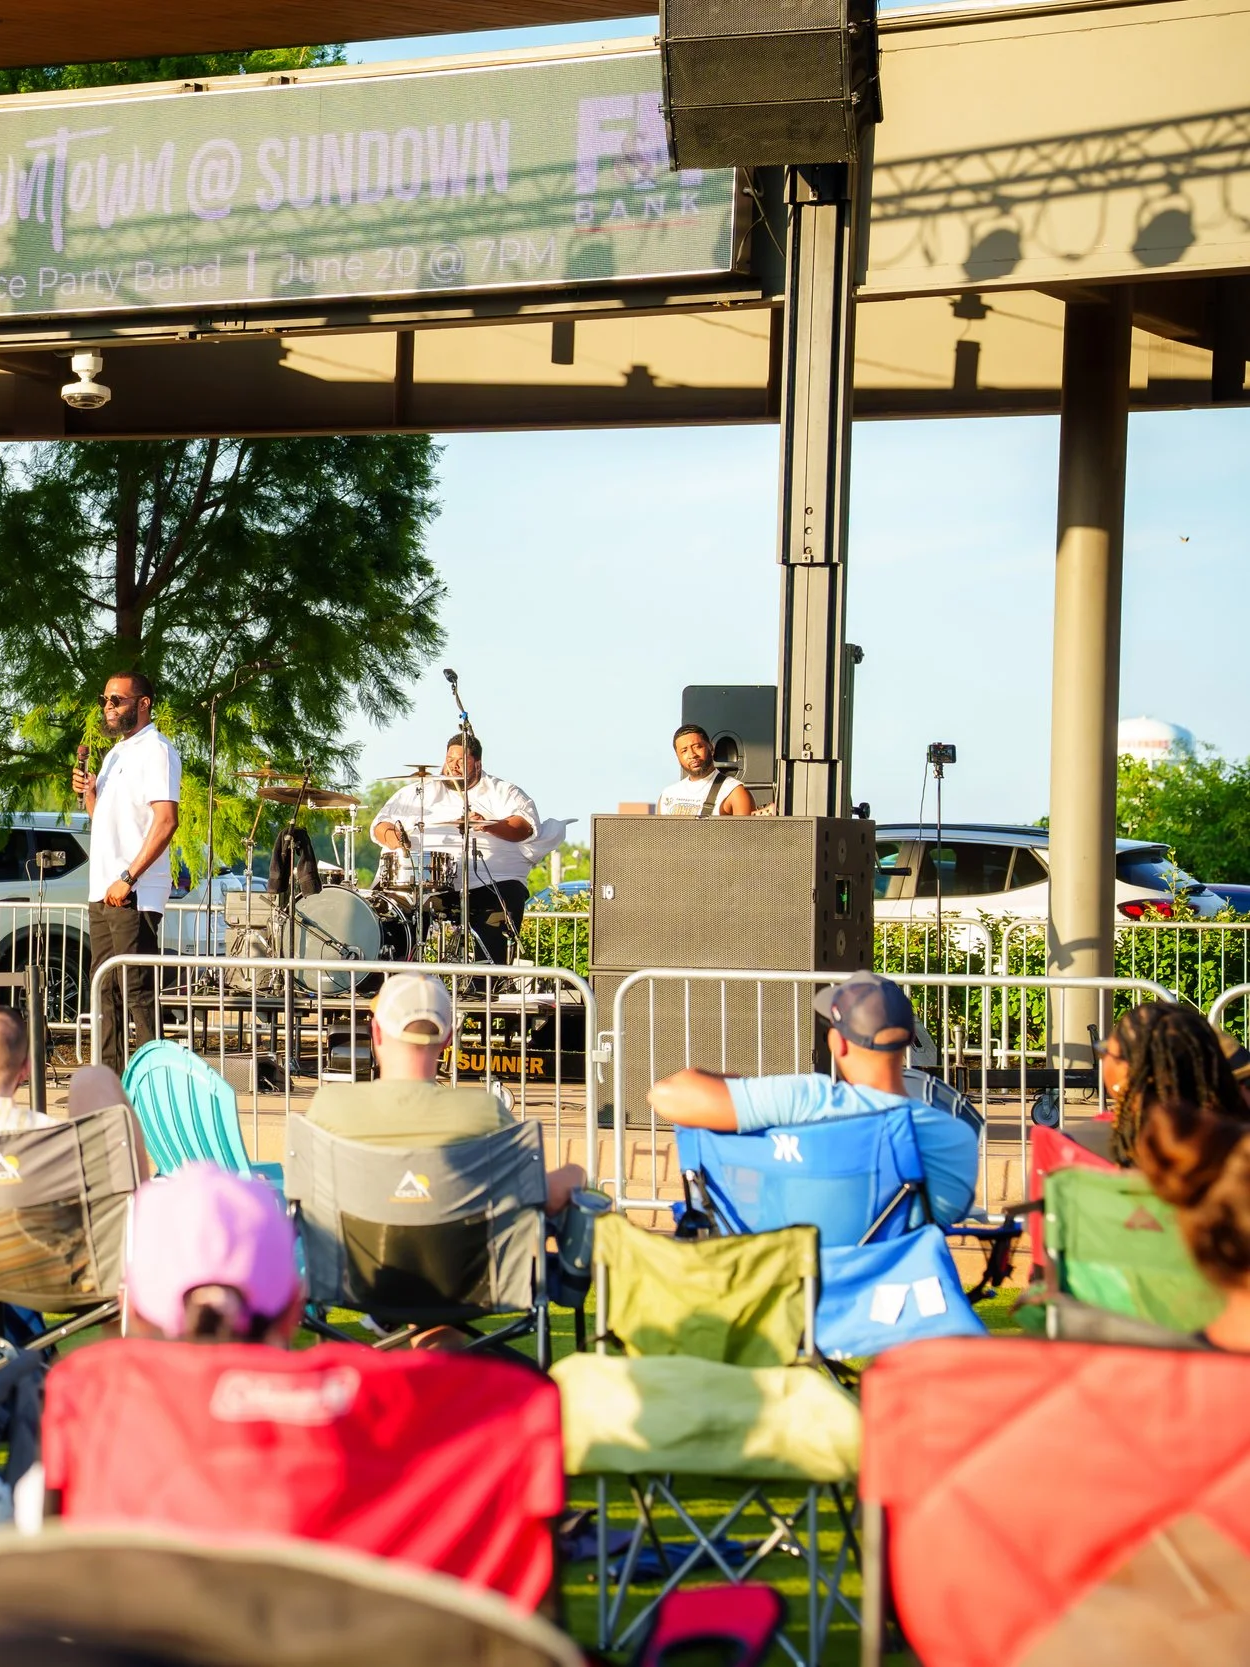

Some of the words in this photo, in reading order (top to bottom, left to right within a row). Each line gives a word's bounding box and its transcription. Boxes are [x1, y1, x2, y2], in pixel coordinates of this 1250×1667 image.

[188, 138, 241, 221] @
[256, 119, 511, 211] SUNDOWN
[574, 193, 701, 224] BANK
[38, 267, 124, 299] Party
[134, 254, 221, 292] Band
[279, 252, 365, 286] June
[375, 246, 418, 279] 20
[428, 243, 465, 284] @
[475, 235, 556, 274] 7PM
[457, 1053, 545, 1075] SUMNER
